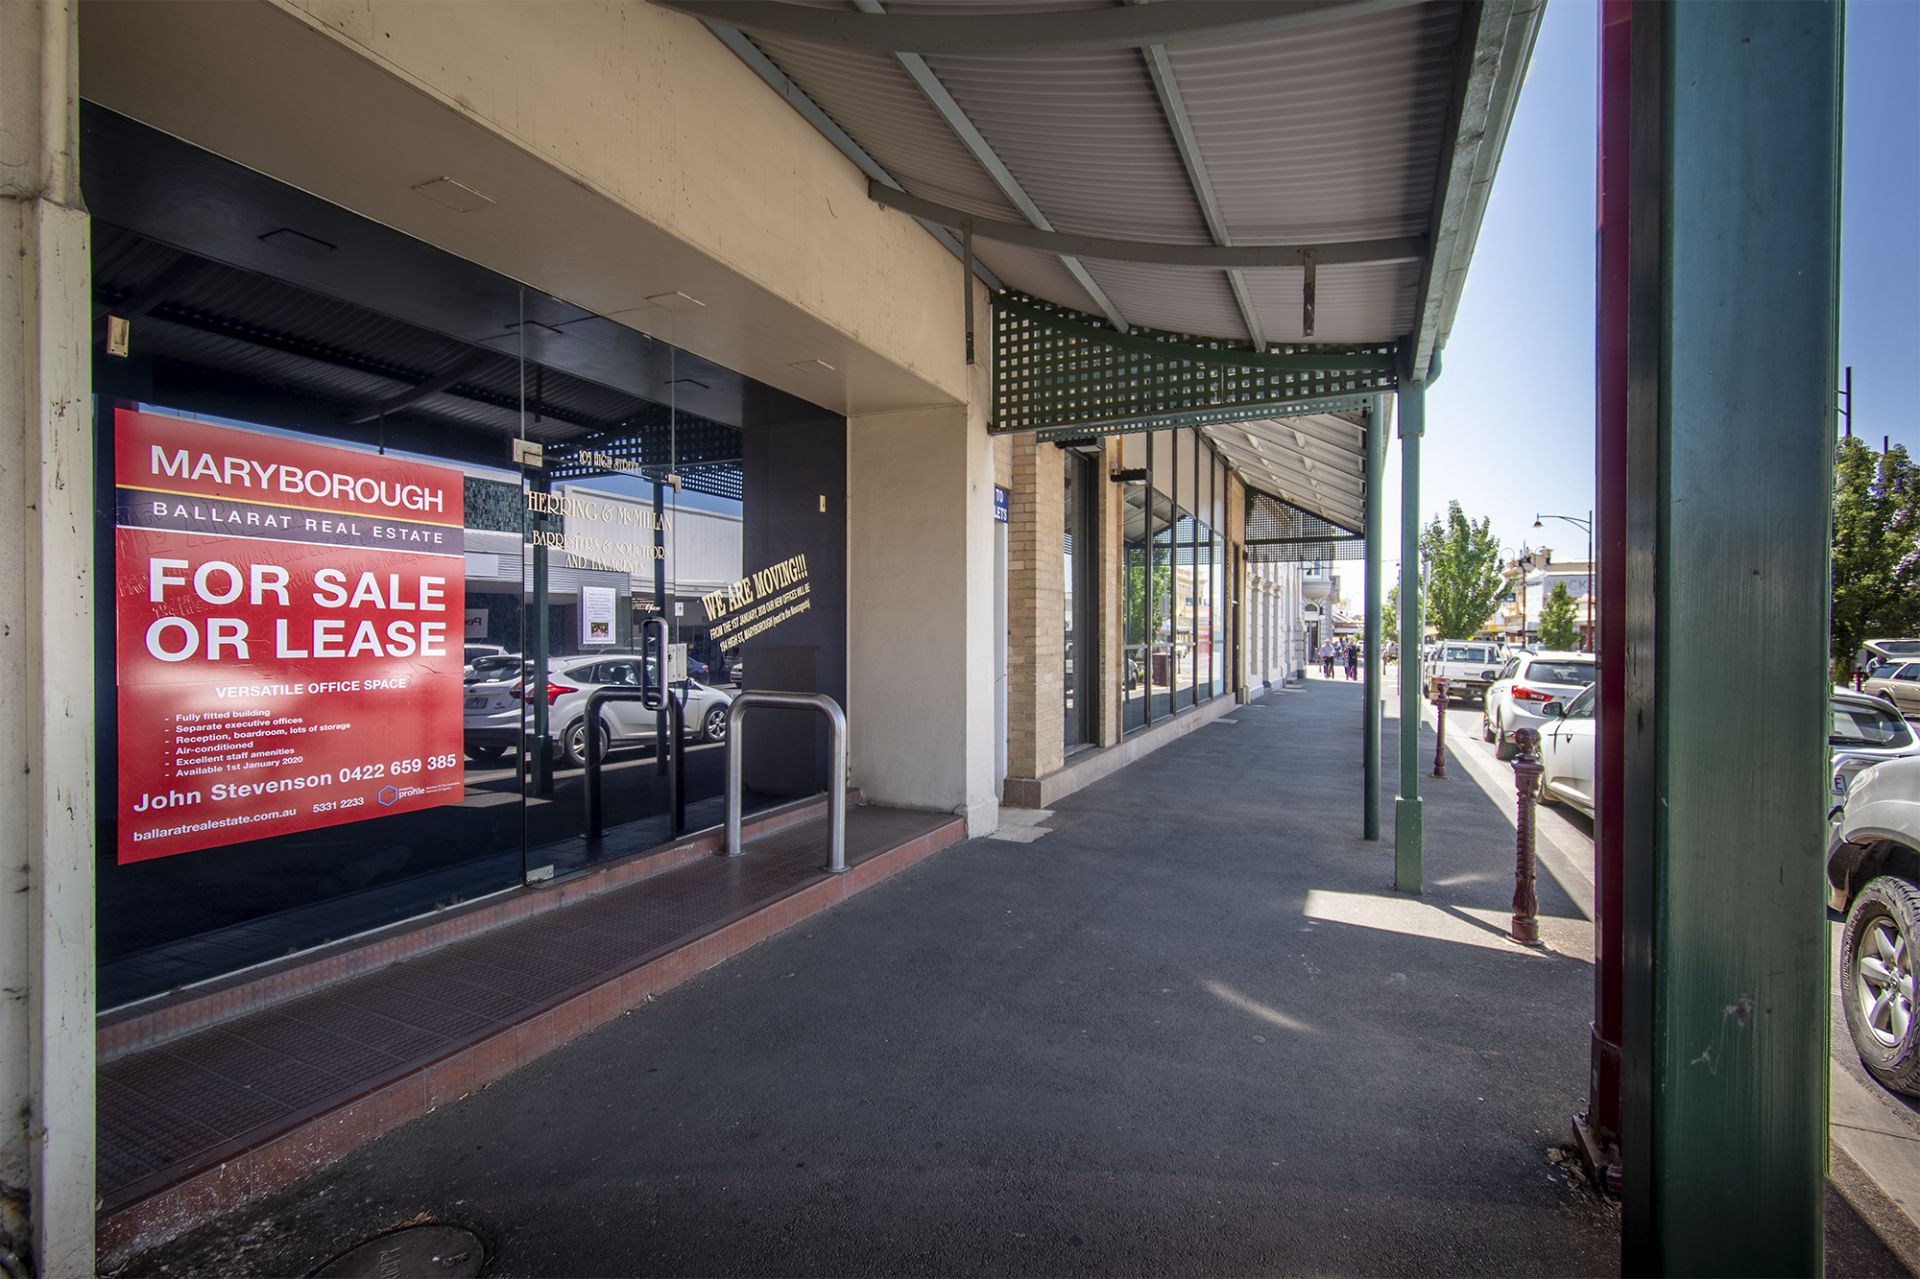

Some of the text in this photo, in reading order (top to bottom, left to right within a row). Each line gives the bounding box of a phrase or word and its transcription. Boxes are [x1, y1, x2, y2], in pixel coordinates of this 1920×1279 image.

[594, 453, 612, 468] HIGH
[151, 444, 444, 512] MARYBOROUGH
[528, 491, 597, 521] HERRING
[601, 503, 613, 523] &
[153, 503, 443, 544] BALLARAT REAL ESTATE
[532, 530, 669, 560] BARRISTERS & SOLICITORS
[565, 554, 645, 574] AND TAX AGENTS
[150, 558, 291, 607] FOR
[312, 569, 447, 611] SALE
[702, 553, 808, 621] WE ARE MOVING!!!
[709, 624, 724, 640] FROM
[723, 622, 732, 633] THE
[739, 608, 759, 626] JANUARY,
[766, 600, 776, 613] OUR
[774, 596, 784, 609] NEW
[783, 588, 798, 604] OFFICES
[796, 584, 805, 598] WILL
[804, 582, 811, 593] BE
[146, 616, 447, 662] OR LEASE
[727, 634, 739, 649] HIGH
[744, 617, 774, 640] MARYBOROUGH
[216, 678, 407, 699] VERSATILE OFFICE SPACE
[176, 709, 271, 722] Fully fitted building
[176, 717, 303, 733] Separate executive offices
[175, 741, 253, 755] Air-conditioned
[176, 732, 231, 745] Reception,
[234, 728, 288, 739] boardroom,
[320, 723, 351, 732] storage
[175, 767, 223, 777] Available
[243, 760, 281, 770] January
[282, 755, 304, 765] 2020
[176, 748, 295, 766] Excellent staff amenities
[133, 754, 457, 812] John Stevenson 0422 659 385
[399, 787, 425, 799] profile
[133, 796, 365, 842] ballaratrealestate.com.au 5331 2233
